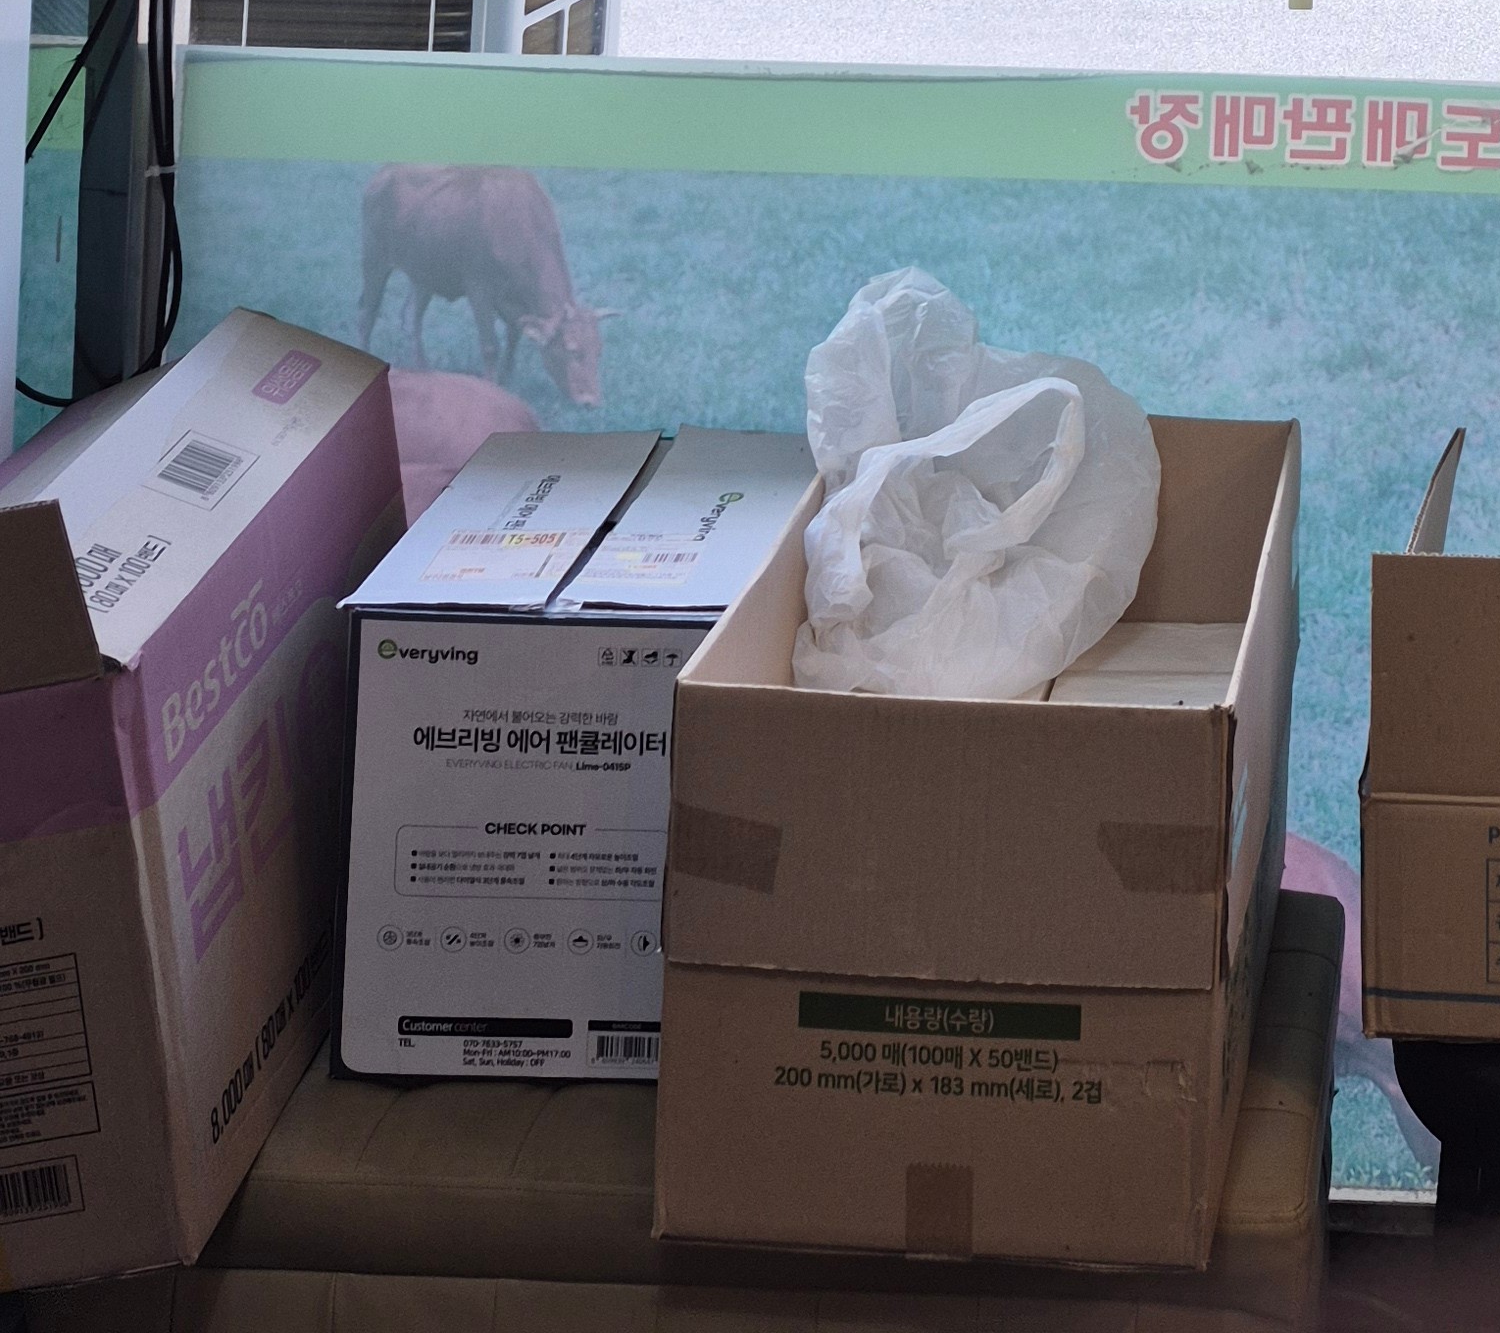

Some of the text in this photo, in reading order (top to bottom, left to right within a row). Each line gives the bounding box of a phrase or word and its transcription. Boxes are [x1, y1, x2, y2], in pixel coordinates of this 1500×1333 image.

[414, 726, 666, 756] 에브리빙 에어 팬큘레이터
[485, 823, 586, 836] CHECK POINT
[402, 1019, 453, 1033] Customer
[884, 1004, 994, 1034] 내용량(수량)
[819, 1041, 876, 1064] 5,000
